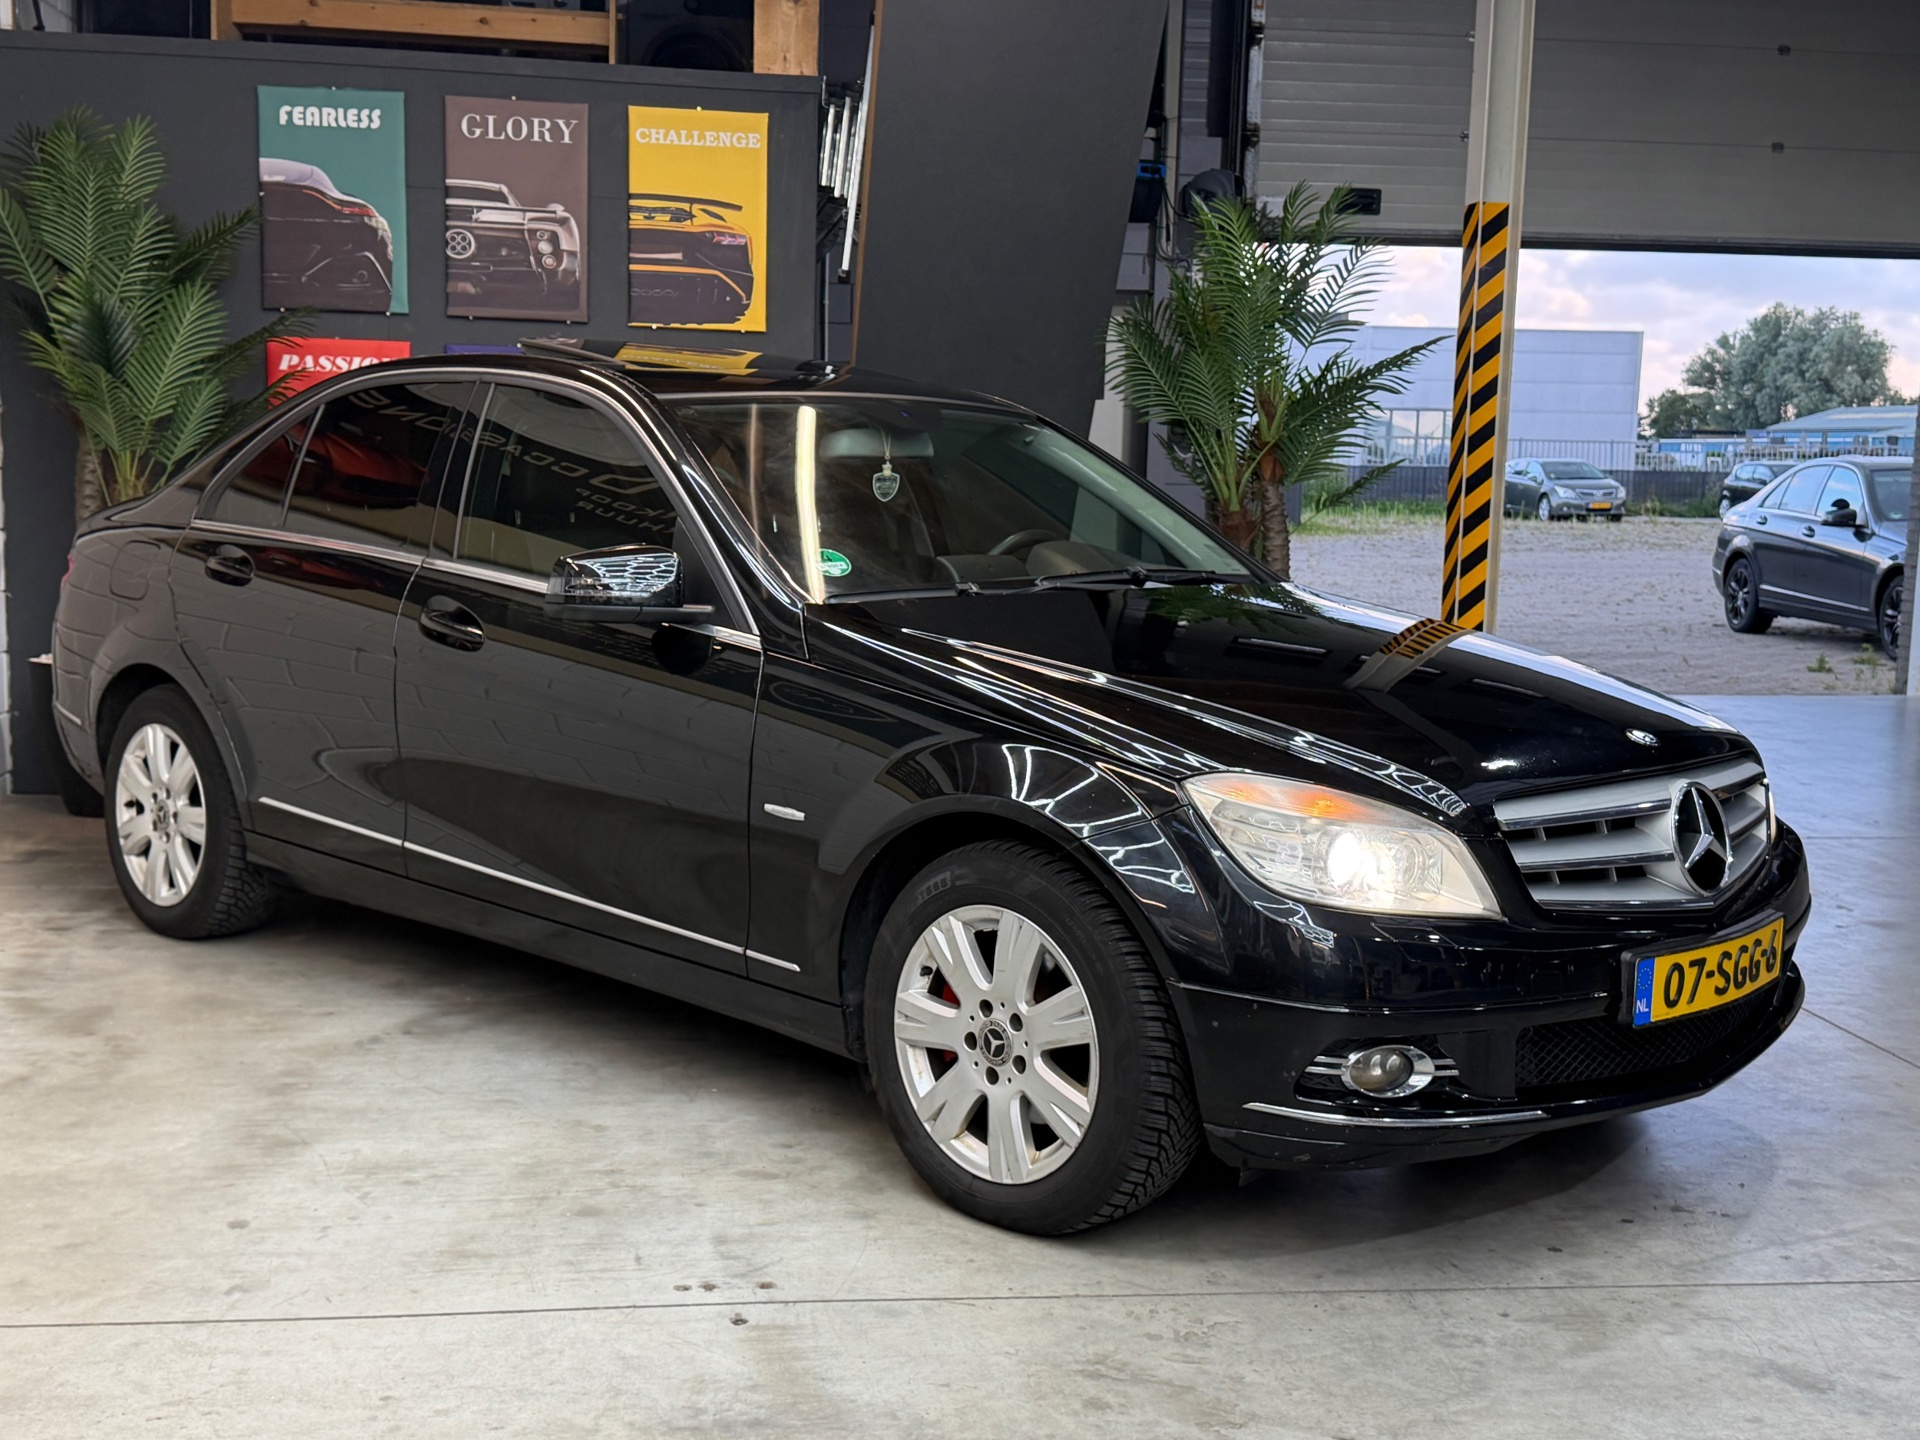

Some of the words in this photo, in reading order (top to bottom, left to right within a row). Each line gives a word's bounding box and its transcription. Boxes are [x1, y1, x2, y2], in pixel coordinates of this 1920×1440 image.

[278, 104, 382, 130] FEARLESS
[460, 113, 579, 145] GLORY
[635, 127, 762, 149] CHALLENGE
[278, 353, 398, 373] PASSIO
[1663, 929, 1778, 1010] 07-SGG-6
[1635, 998, 1650, 1014] NL
